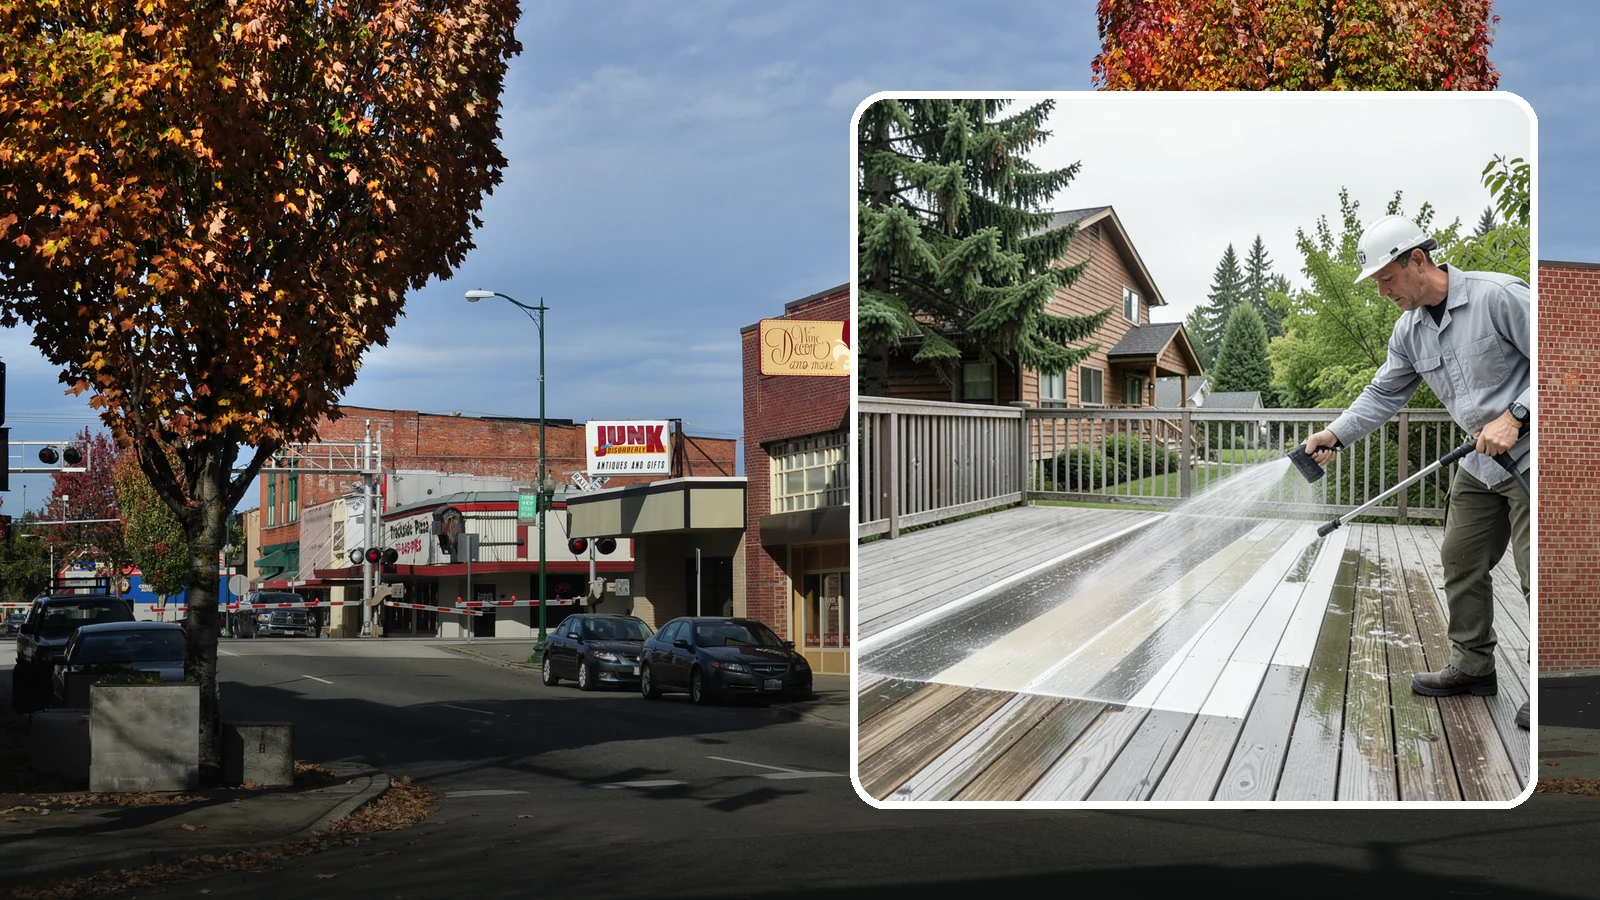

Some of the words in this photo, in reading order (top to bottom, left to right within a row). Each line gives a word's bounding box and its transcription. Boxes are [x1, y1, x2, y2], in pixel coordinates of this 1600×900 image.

[595, 425, 665, 457] JUNK
[607, 446, 646, 454] DISORDERLY
[597, 461, 628, 470] ANTIQUES
[631, 461, 644, 470] AND
[647, 460, 665, 470] GIFTS
[573, 473, 589, 492] RAIL
